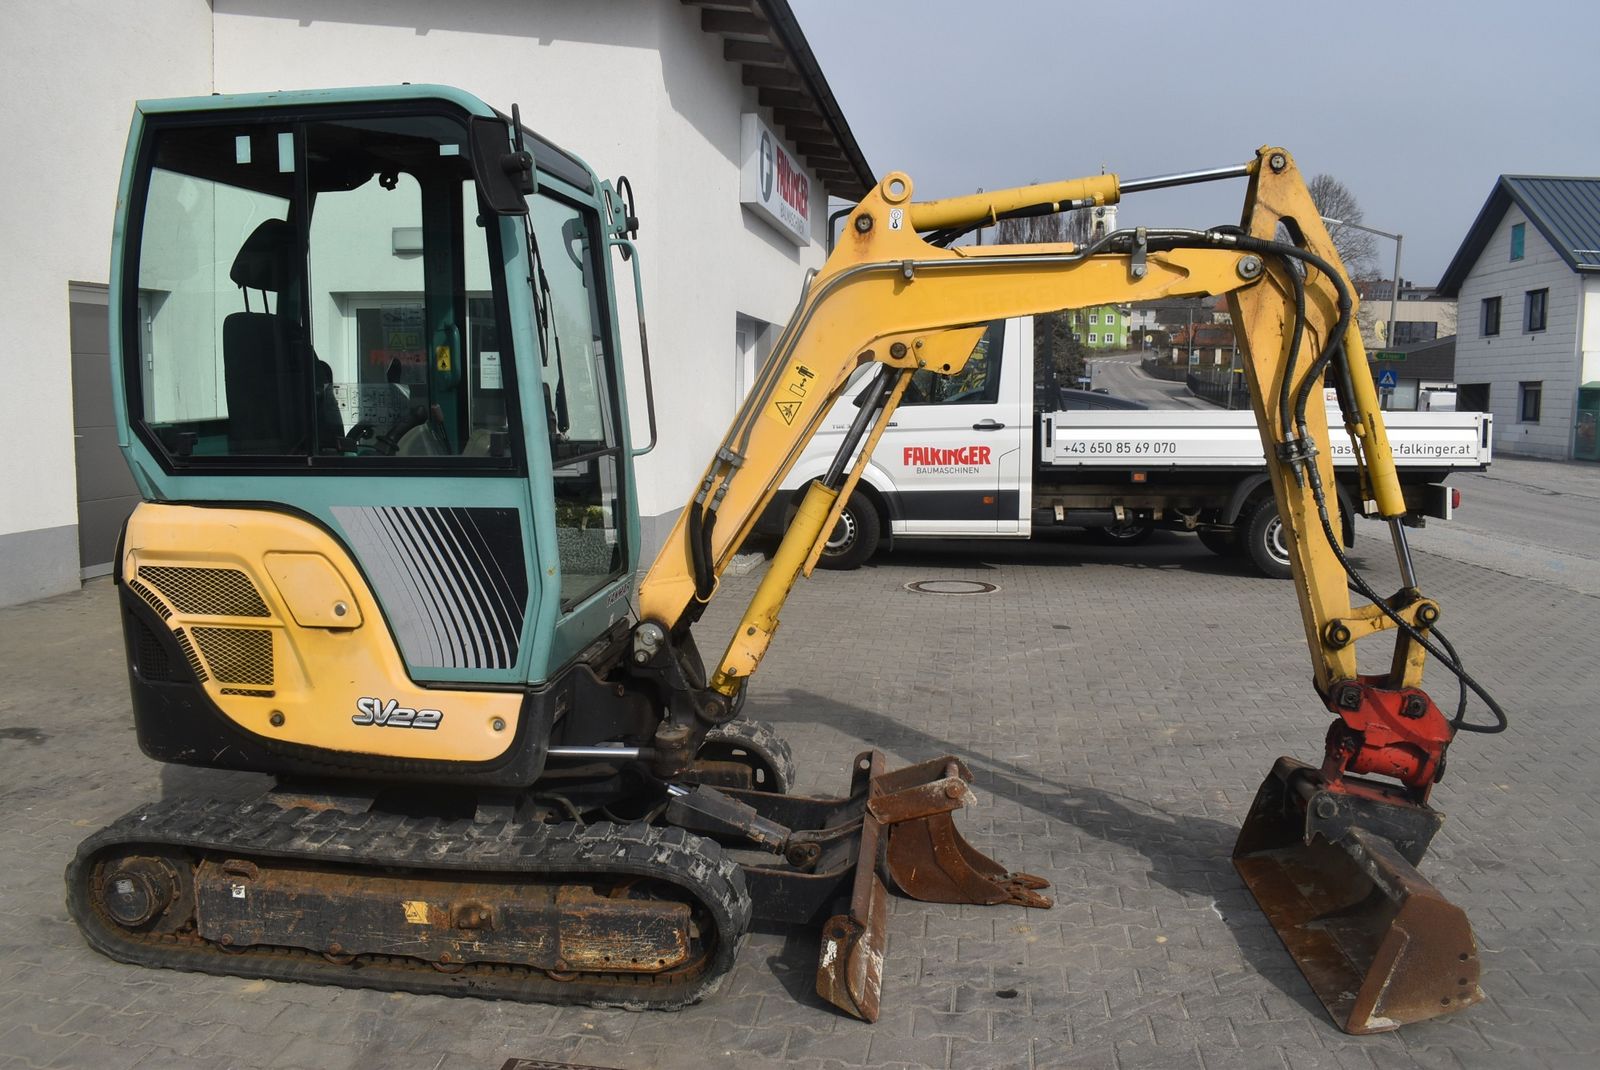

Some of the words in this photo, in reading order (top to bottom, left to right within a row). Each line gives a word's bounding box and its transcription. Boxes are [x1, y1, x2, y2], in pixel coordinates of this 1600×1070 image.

[903, 446, 991, 466] FALKINGER
[1063, 442, 1086, 454] +43
[1090, 442, 1112, 454] 650
[1116, 442, 1131, 454] 85
[1135, 442, 1150, 454] 69
[1153, 442, 1176, 454] 070
[352, 696, 444, 730] SV22
